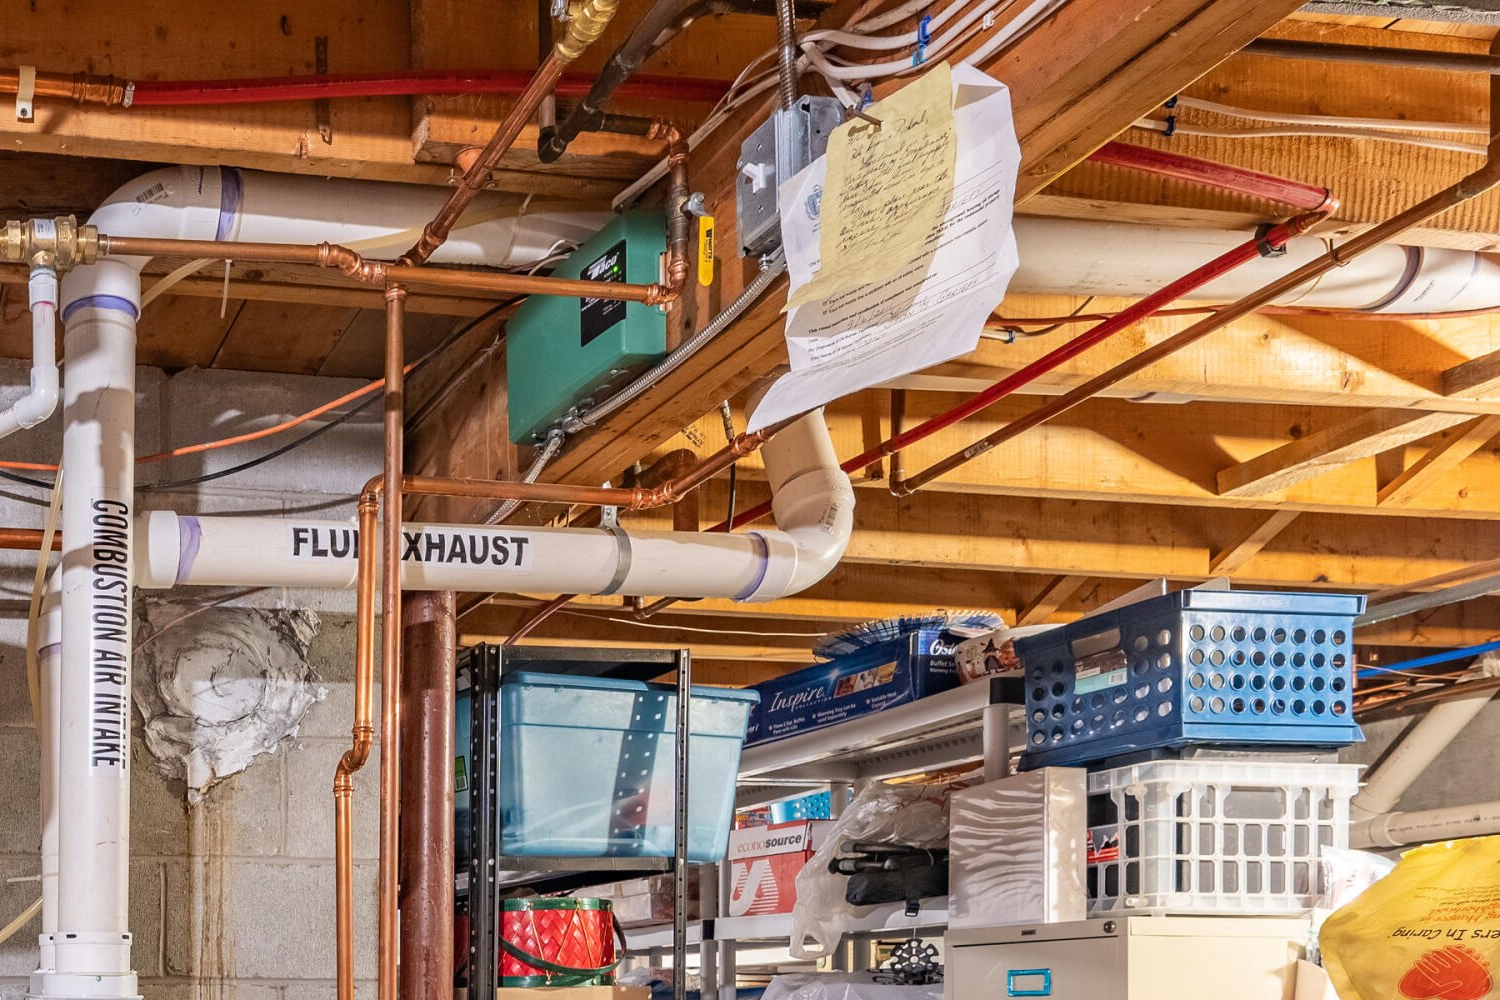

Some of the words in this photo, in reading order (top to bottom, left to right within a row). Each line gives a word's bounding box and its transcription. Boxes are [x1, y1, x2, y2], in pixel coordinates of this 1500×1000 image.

[402, 531, 530, 567] XHAUST
[92, 499, 129, 643] COMBUSTION
[93, 648, 127, 686] AIR
[768, 685, 824, 714] Inspire
[92, 692, 127, 770] INTAKE
[1392, 926, 1442, 940] Caring
[1446, 929, 1470, 941] In
